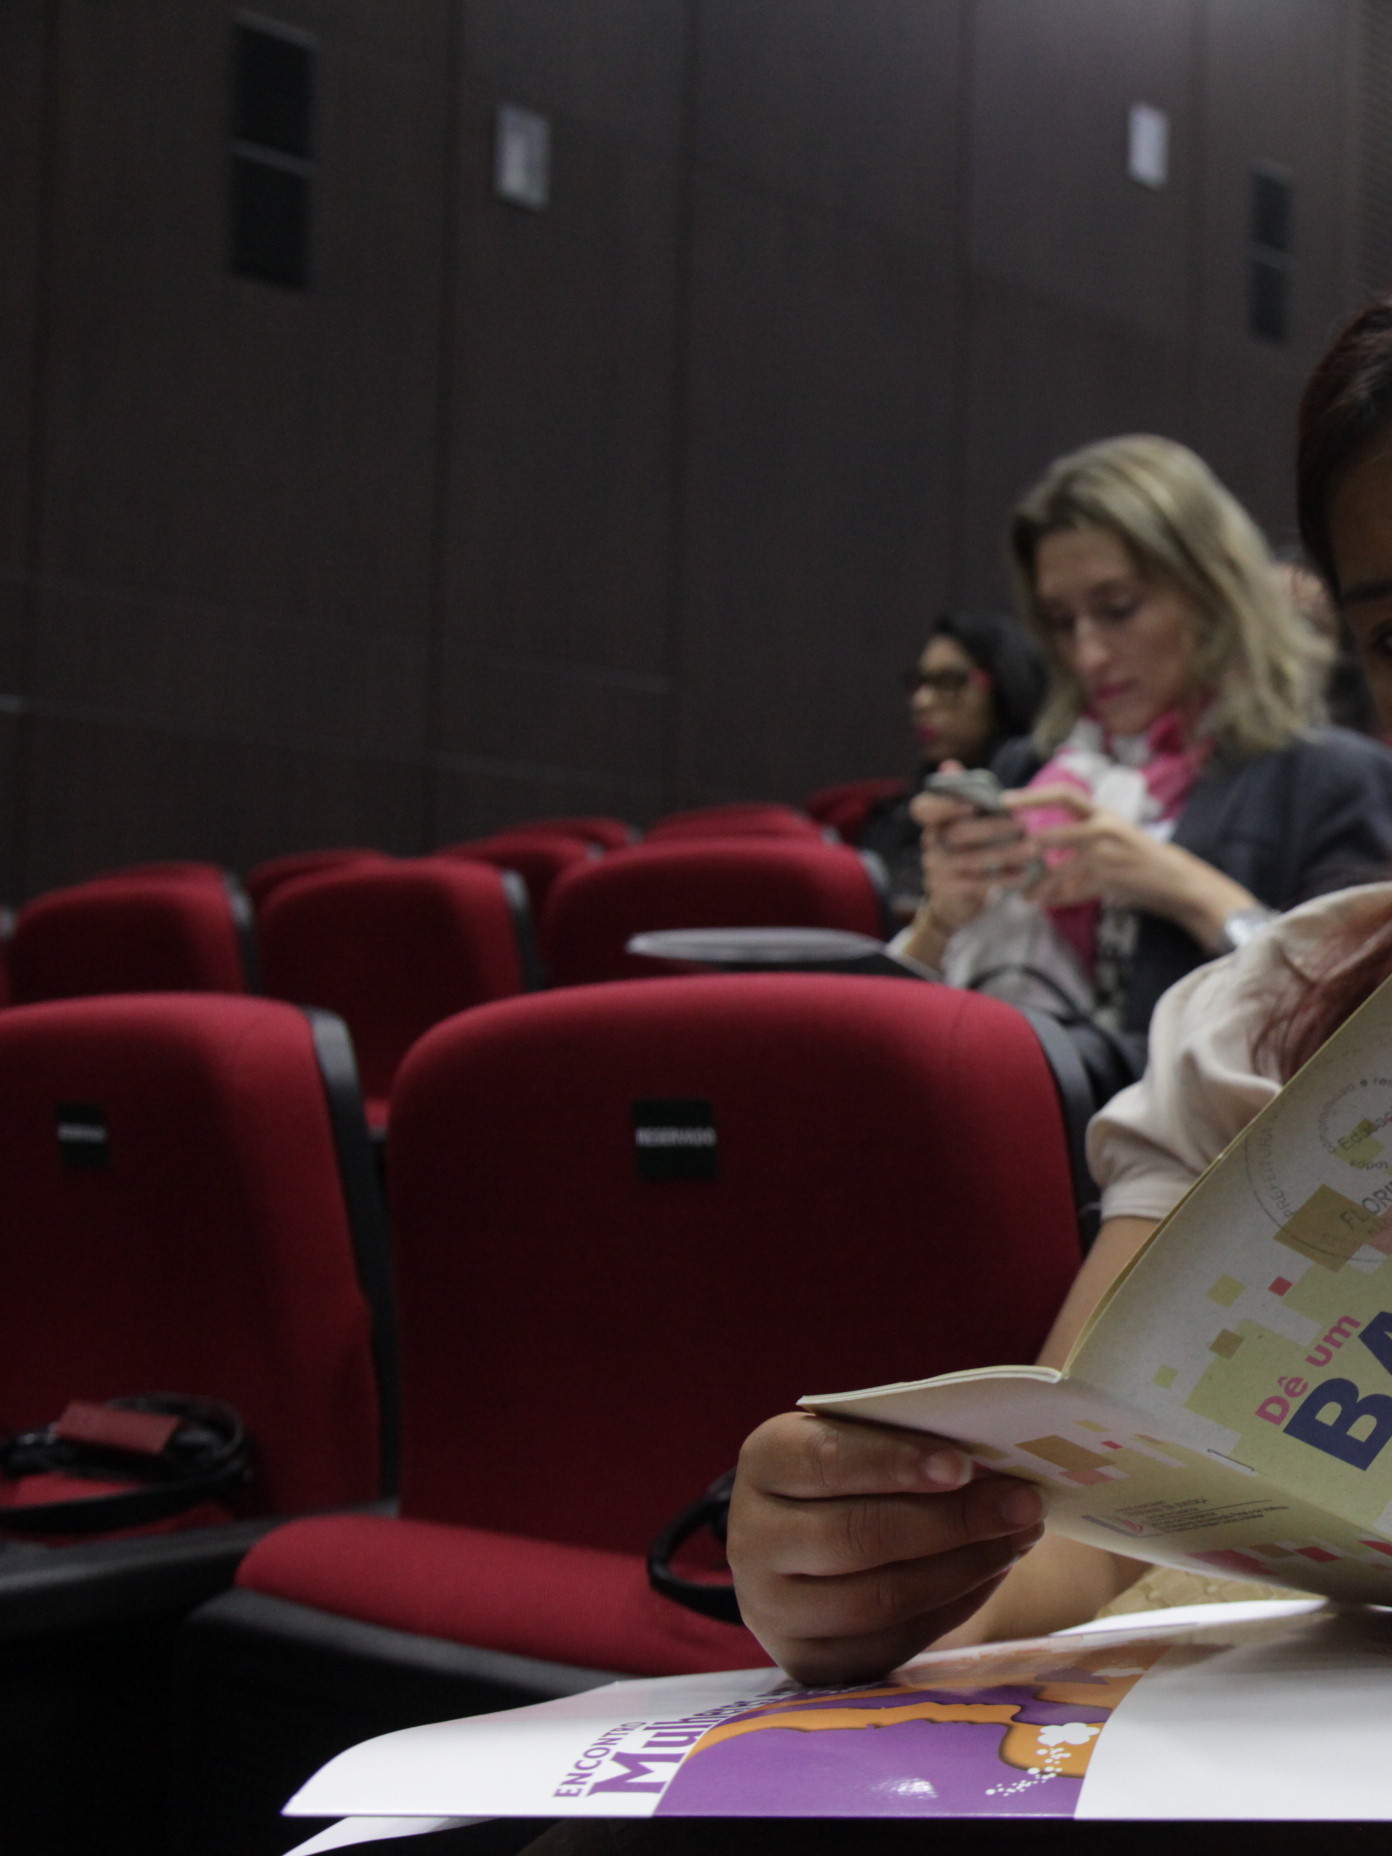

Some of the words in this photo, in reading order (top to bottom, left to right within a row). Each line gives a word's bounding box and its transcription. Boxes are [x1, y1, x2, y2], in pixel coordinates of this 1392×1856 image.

[1254, 1374, 1309, 1426] Dê
[1305, 1315, 1361, 1368] um
[553, 1721, 648, 1797] ENCONTRO
